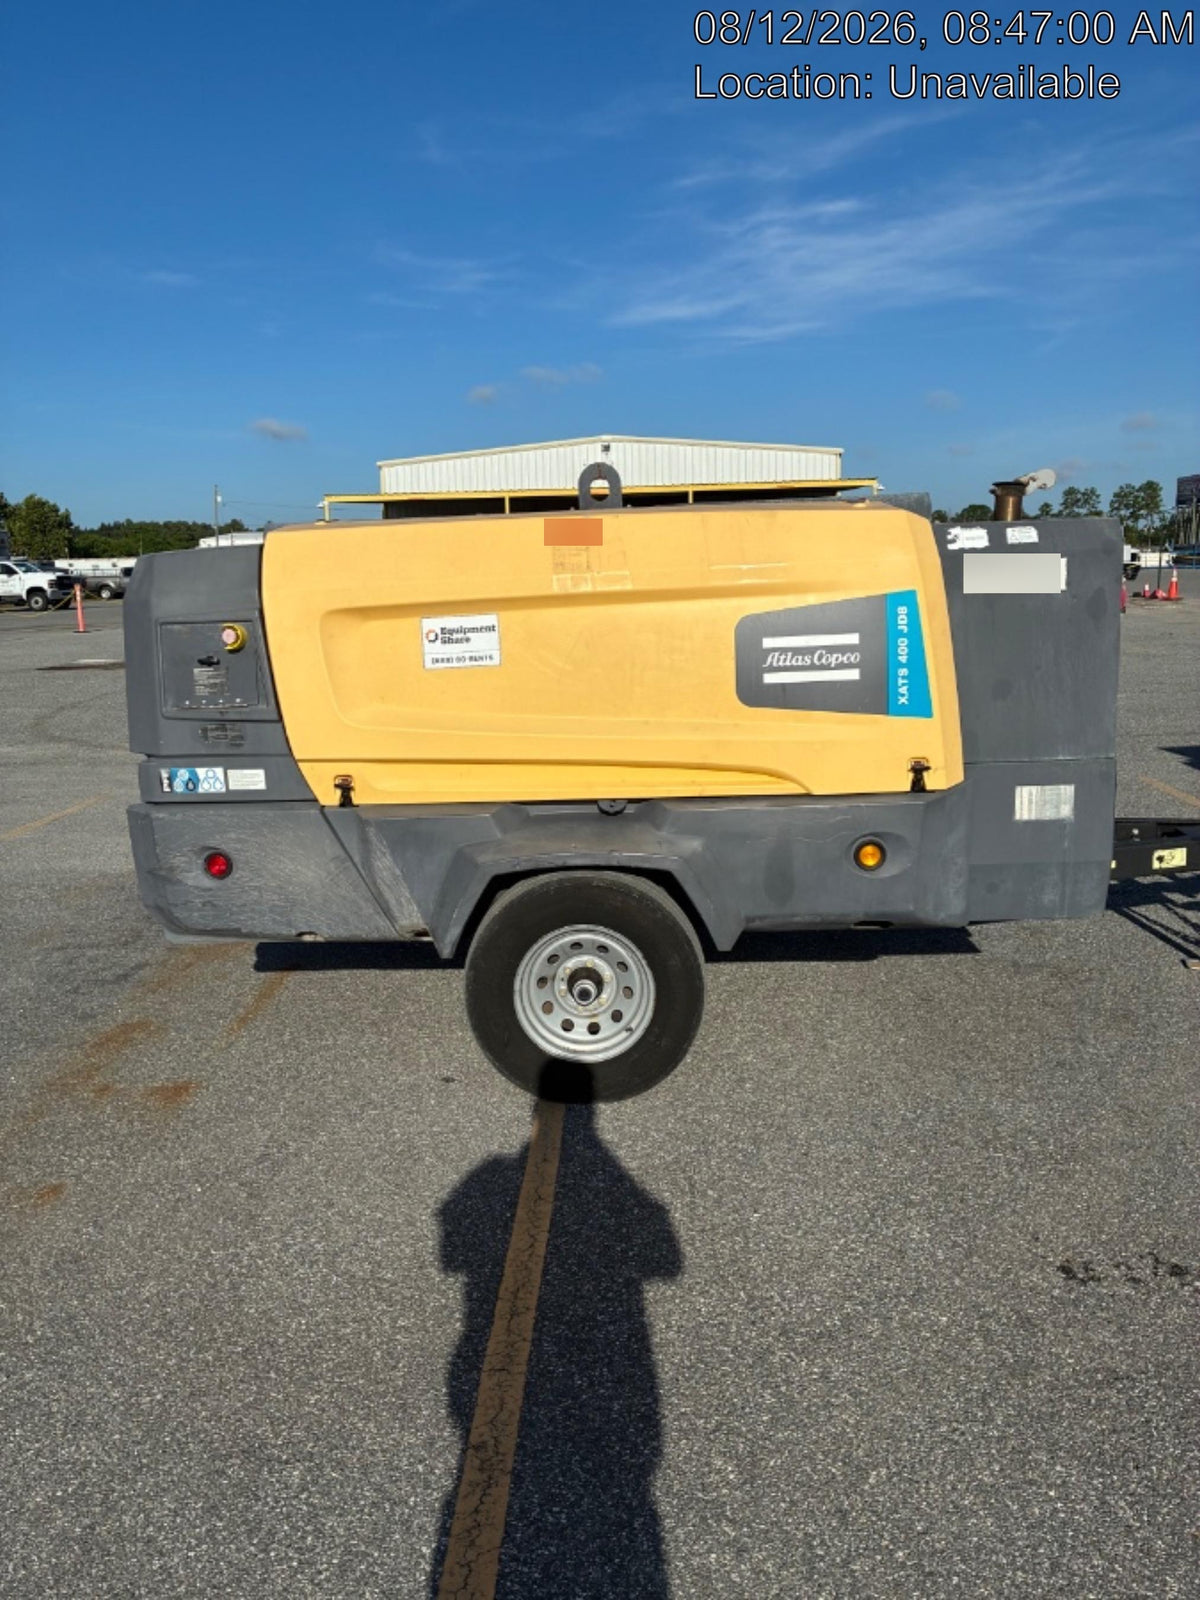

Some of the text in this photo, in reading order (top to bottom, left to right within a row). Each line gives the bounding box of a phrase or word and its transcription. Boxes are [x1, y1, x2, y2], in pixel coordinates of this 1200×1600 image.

[440, 624, 497, 636] Equipment
[440, 636, 471, 645] Share
[762, 649, 861, 668] Atlas Copco
[897, 637, 909, 664] 400
[897, 667, 910, 705] XATS
